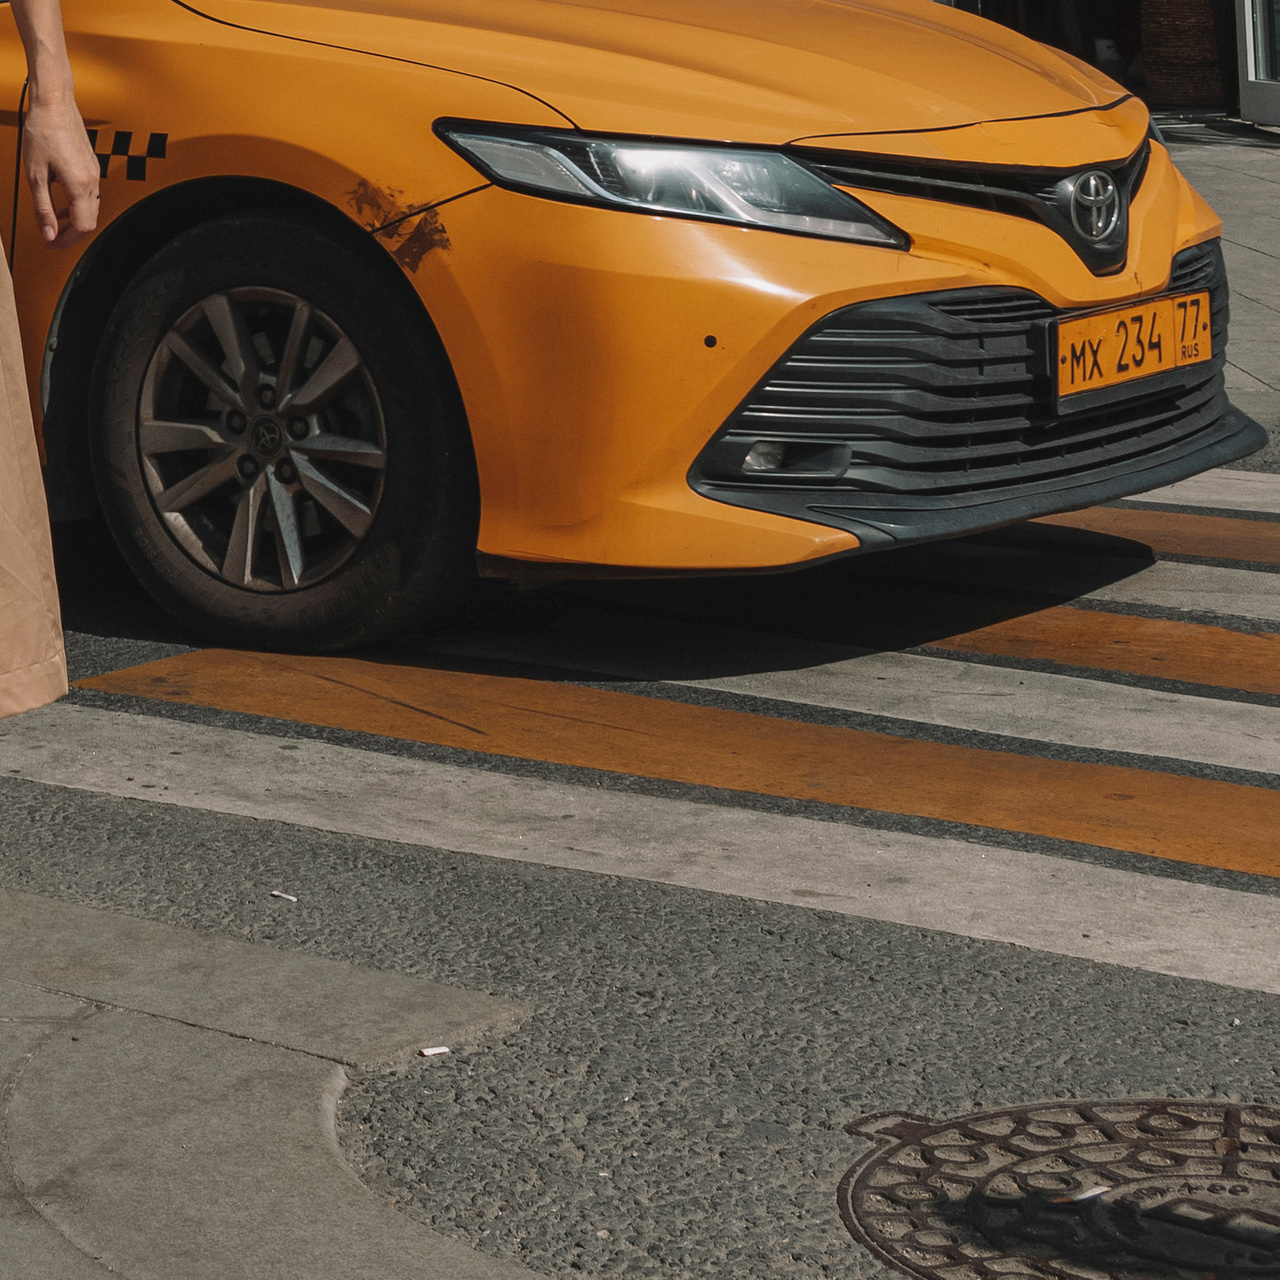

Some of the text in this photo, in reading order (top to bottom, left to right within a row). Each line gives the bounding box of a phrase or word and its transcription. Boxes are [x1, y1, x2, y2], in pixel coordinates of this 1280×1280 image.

[1114, 311, 1163, 374] 234
[1177, 298, 1201, 343] 77
[1181, 342, 1200, 360] RUS
